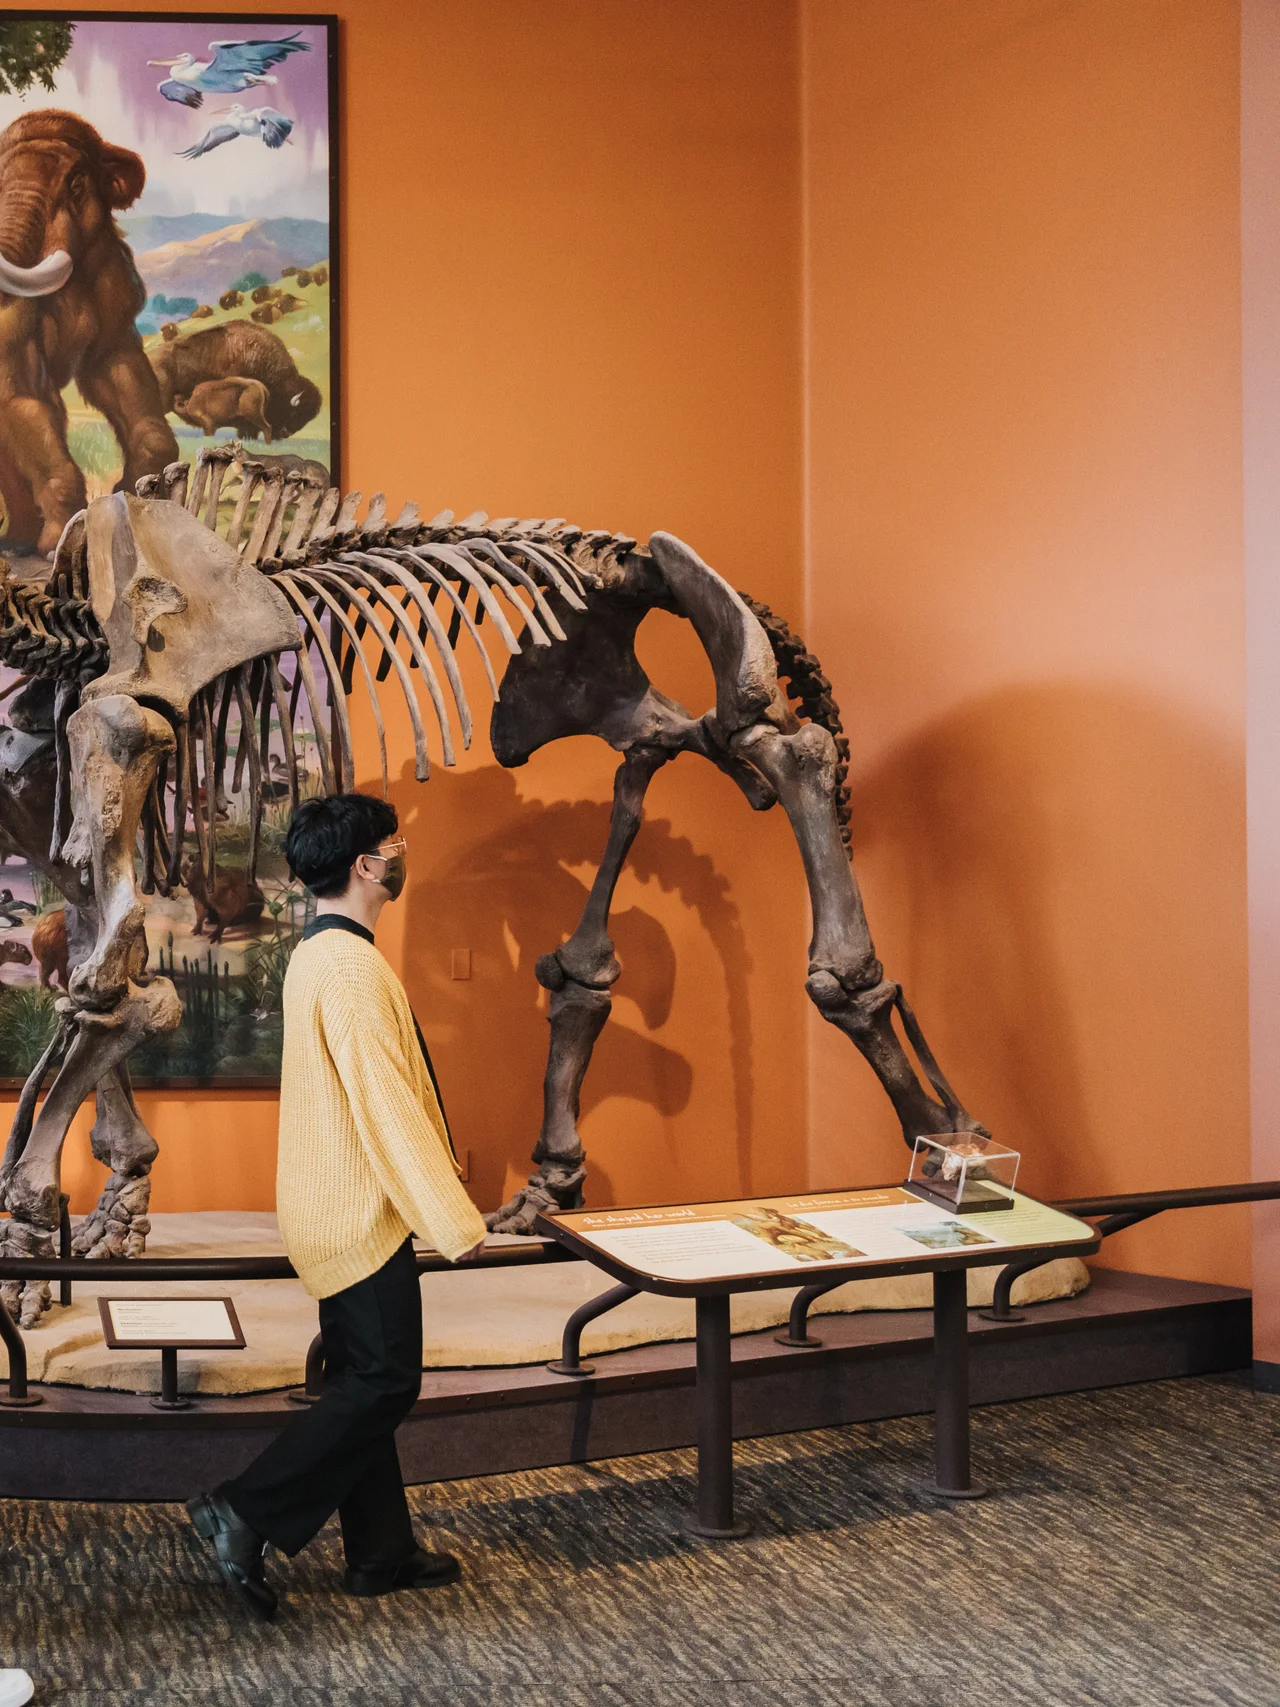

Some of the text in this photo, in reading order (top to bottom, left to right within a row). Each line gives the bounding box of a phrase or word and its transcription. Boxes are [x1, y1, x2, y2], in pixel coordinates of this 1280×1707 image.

[606, 1213, 644, 1225] shaped
[643, 1212, 663, 1220] her
[665, 1209, 696, 1218] world
